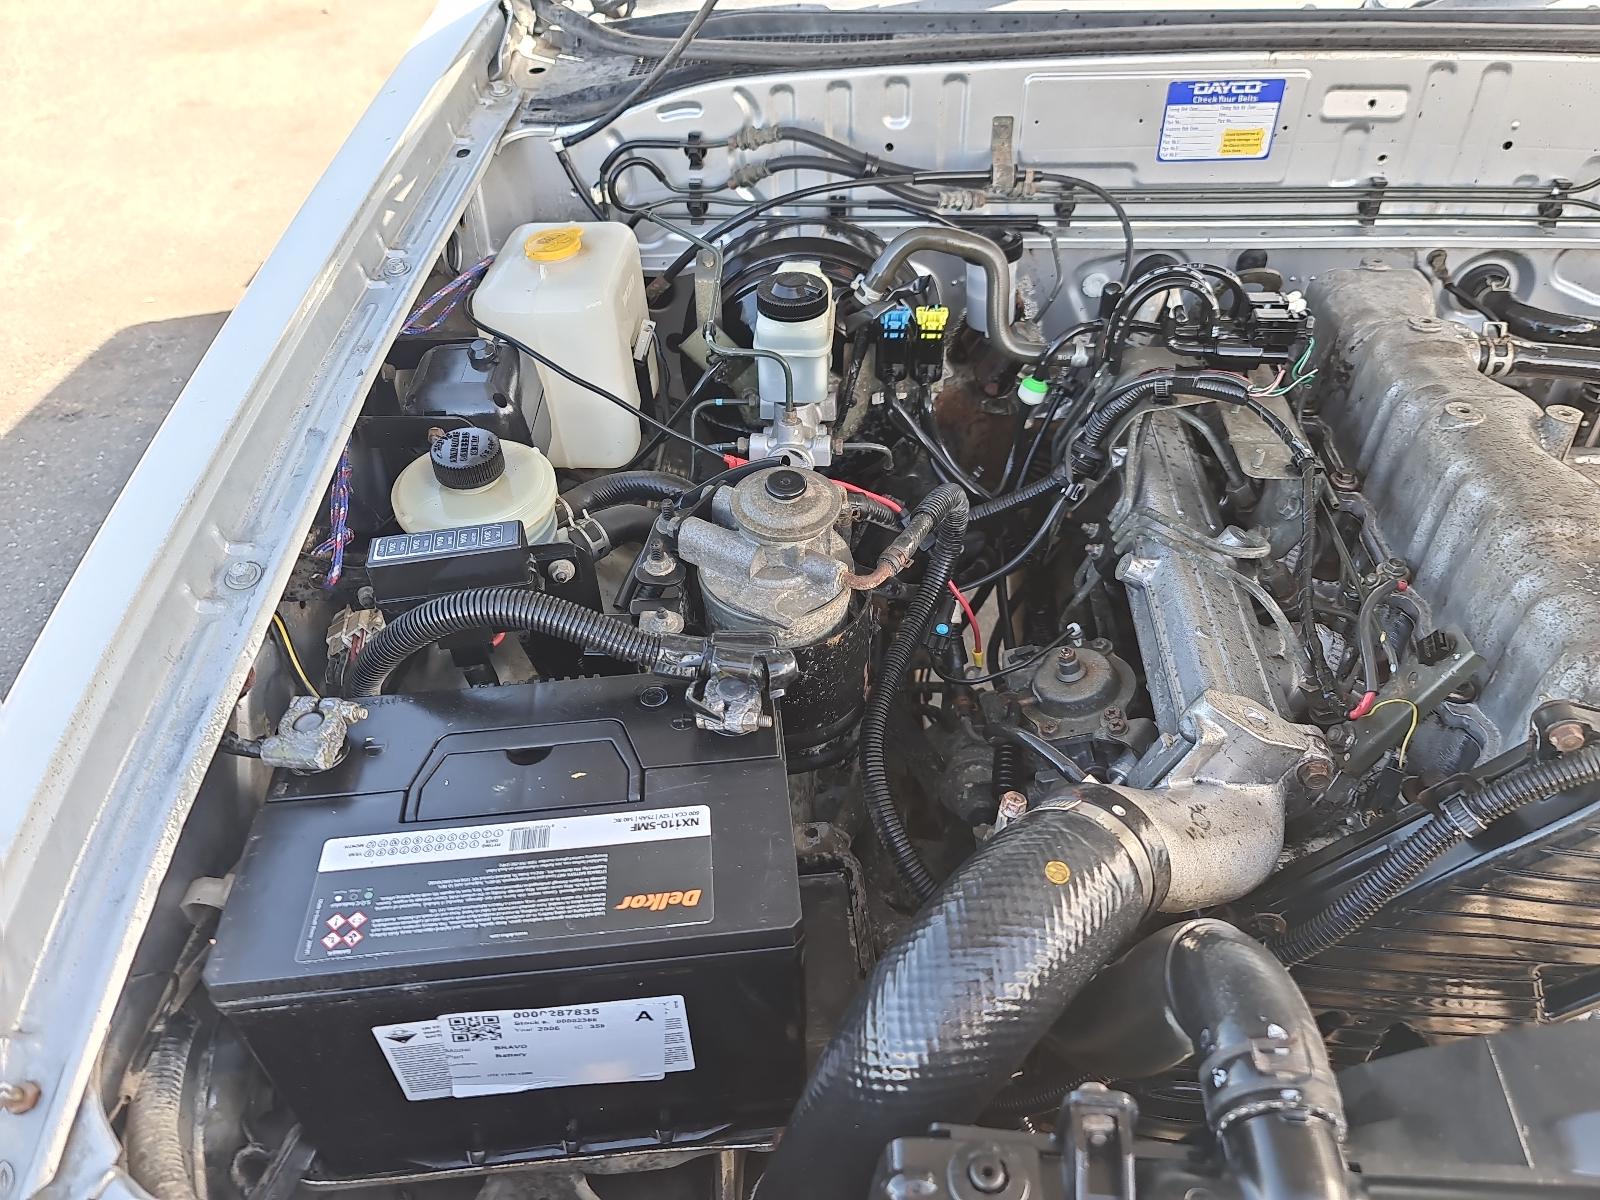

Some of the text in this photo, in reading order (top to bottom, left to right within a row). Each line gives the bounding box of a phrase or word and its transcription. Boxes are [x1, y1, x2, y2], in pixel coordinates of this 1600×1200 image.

[1193, 81, 1263, 94] DAYCO
[1192, 94, 1259, 104] Check Your Belts
[630, 818, 699, 832] NX110-5MF
[613, 889, 702, 911] Delkor
[635, 1010, 654, 1022] A
